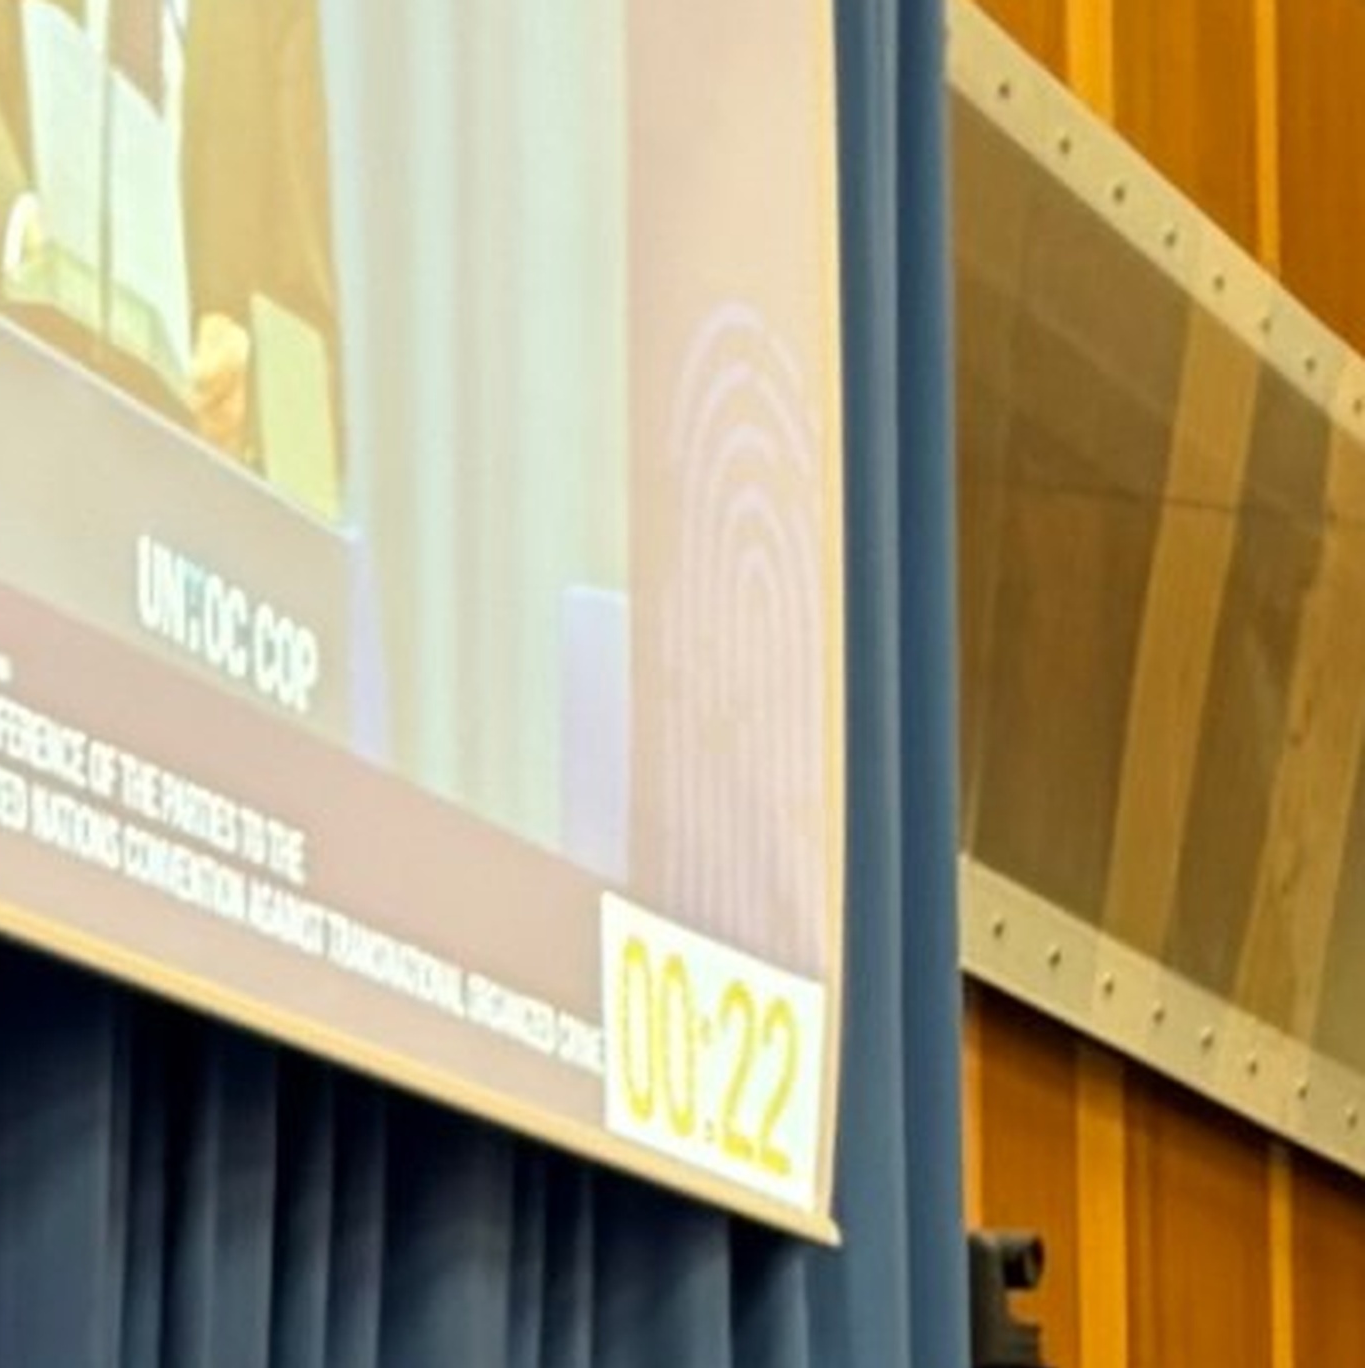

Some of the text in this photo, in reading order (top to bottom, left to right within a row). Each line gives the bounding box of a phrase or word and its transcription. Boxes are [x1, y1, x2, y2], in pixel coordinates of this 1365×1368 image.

[252, 602, 320, 714] COP
[89, 739, 119, 797] OF
[119, 750, 162, 821] THE
[266, 815, 307, 886] THE
[621, 933, 799, 1178] 00:22
